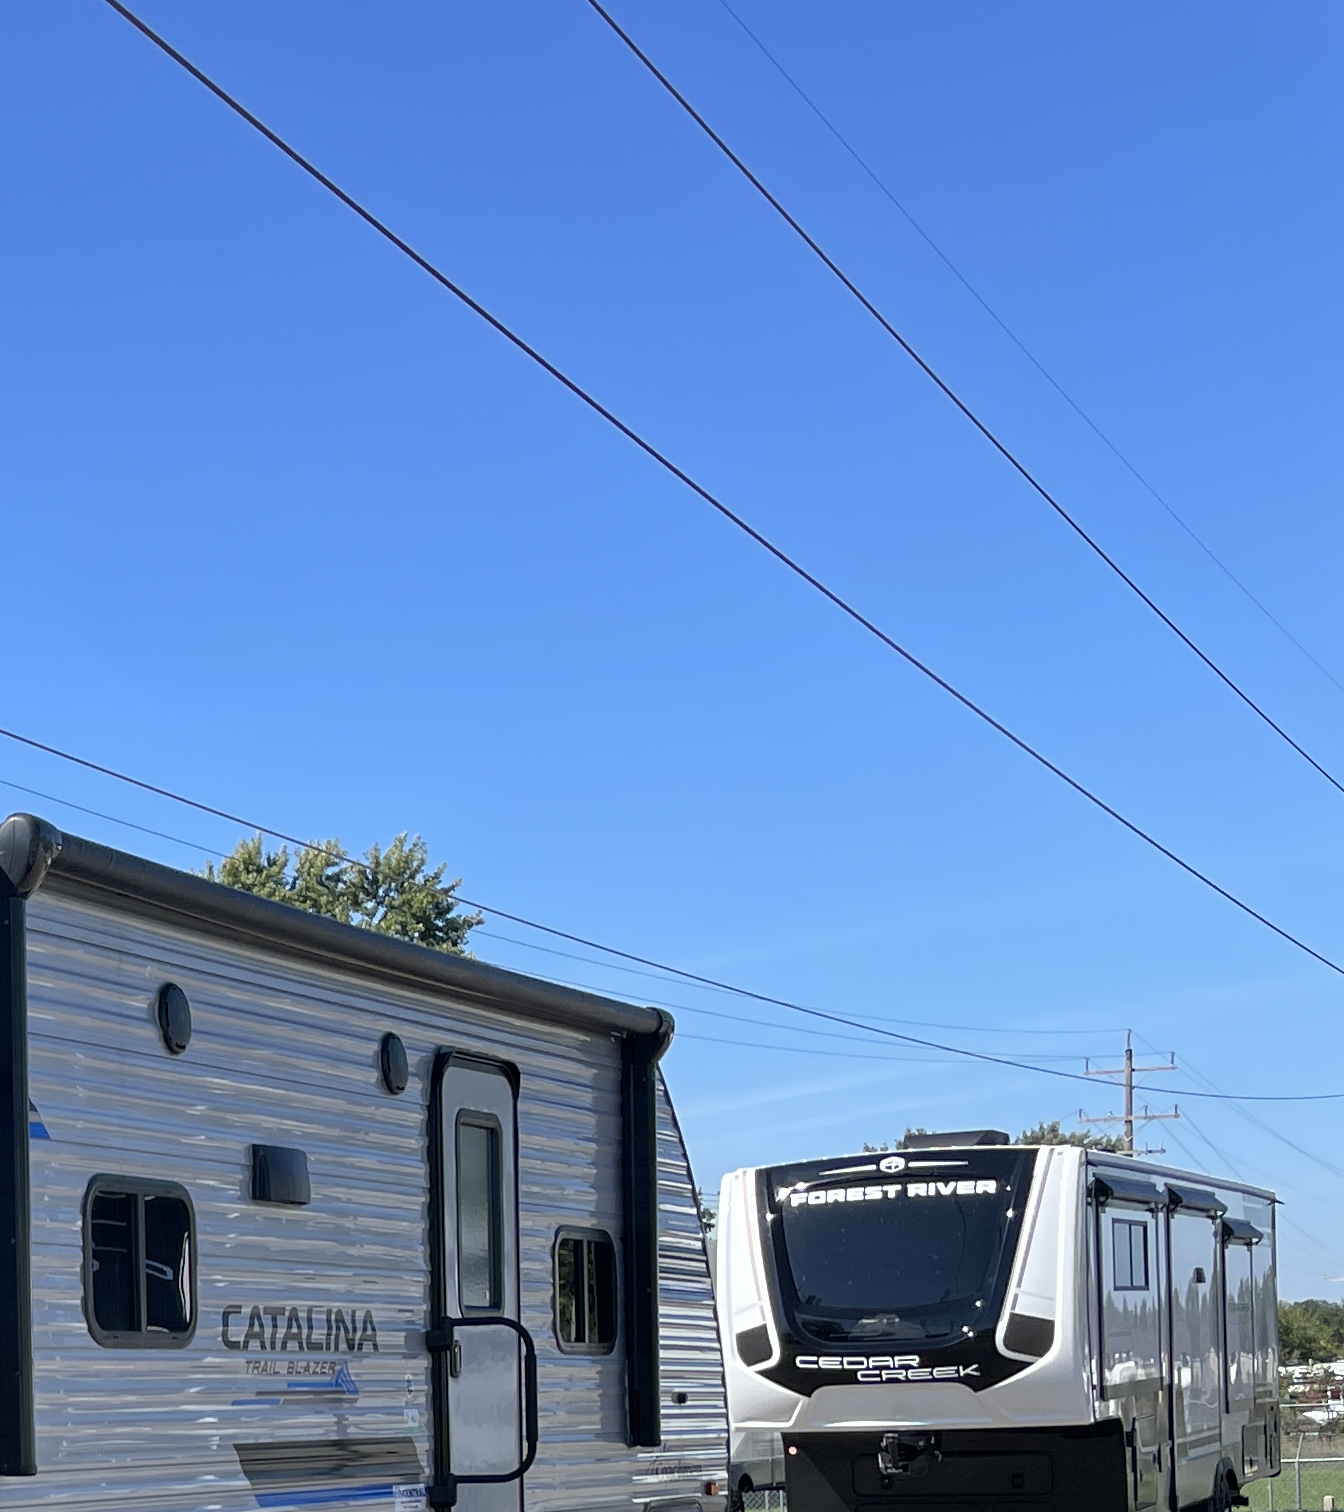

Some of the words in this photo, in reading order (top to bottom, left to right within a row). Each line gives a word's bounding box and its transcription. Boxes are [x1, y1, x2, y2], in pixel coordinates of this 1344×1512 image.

[790, 1184, 902, 1207] FOREST
[907, 1180, 997, 1197] RIVER
[221, 1304, 379, 1352] CATALINA
[245, 1360, 280, 1375] TRAIL
[286, 1360, 337, 1375] BLAZER
[795, 1355, 920, 1369] CEDAR
[857, 1364, 981, 1381] CREEK
